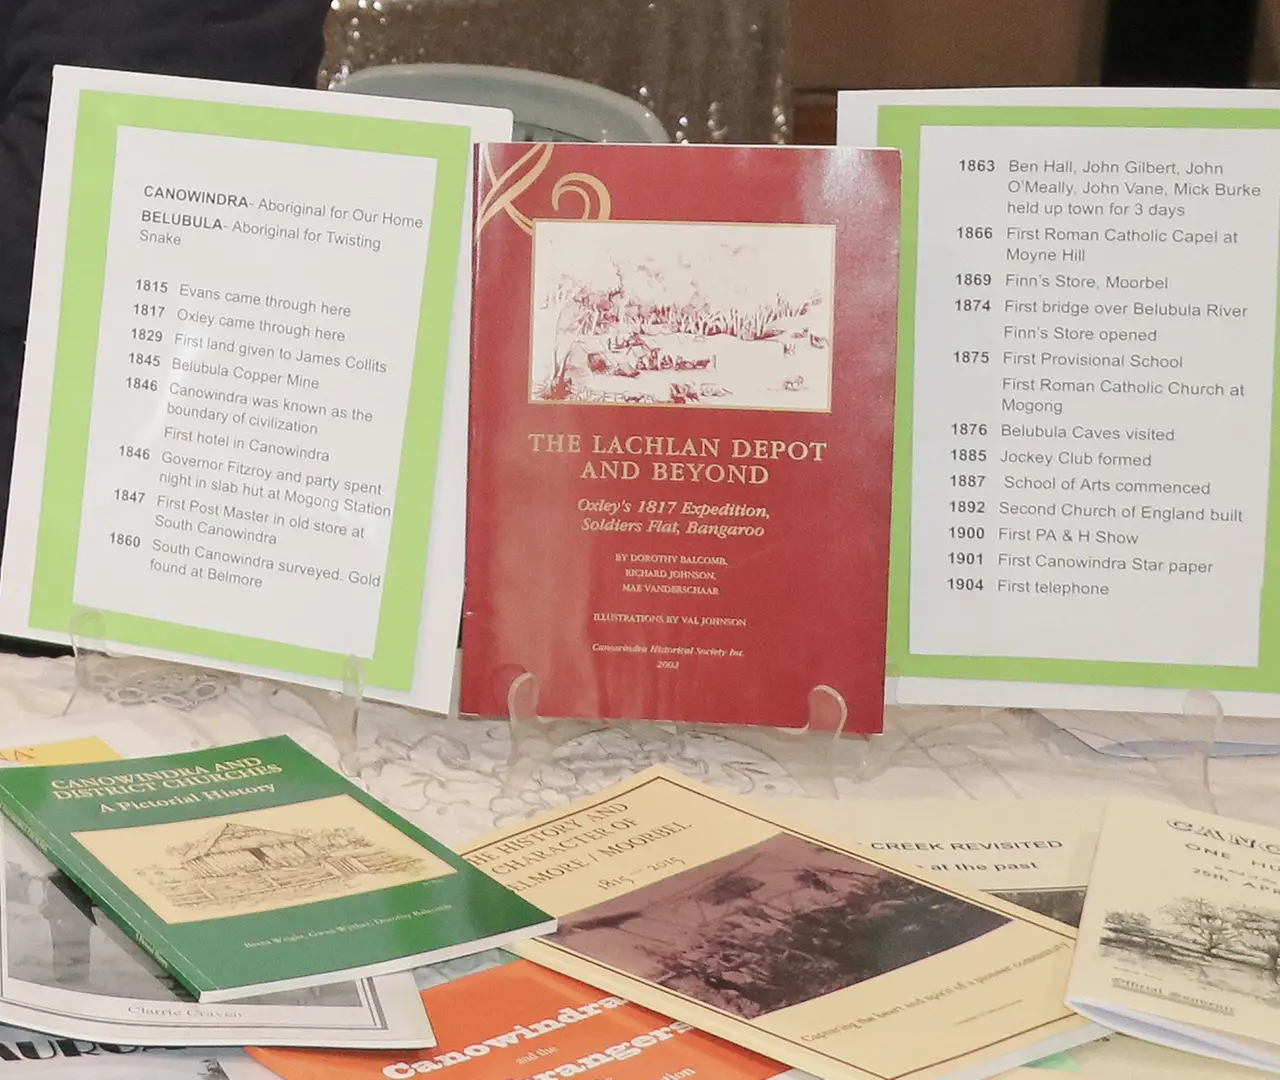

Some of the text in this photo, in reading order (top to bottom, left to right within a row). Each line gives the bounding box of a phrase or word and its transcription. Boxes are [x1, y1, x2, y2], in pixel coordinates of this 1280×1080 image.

[959, 159, 1223, 175] 1863 Ben Hall, John Gilbert, John
[258, 198, 325, 217] Aboriginal
[330, 206, 348, 219] for
[352, 209, 378, 223] Our
[382, 212, 423, 228] Home
[140, 229, 181, 245] Snake
[232, 220, 299, 239] Aboriginal
[304, 228, 322, 242] for
[327, 231, 381, 252] Twisting
[955, 273, 1168, 290] 1869 Finn's Store, Moorbel
[136, 279, 351, 317] 1815 Evans came through here
[131, 328, 386, 370] 1829 First land given to James Collits
[529, 434, 828, 462] THE LACHLAN DEPOT
[580, 461, 769, 484] AND BEYOND
[950, 475, 1210, 495] 1887 School of Arts commenced
[578, 498, 770, 519] Oxley's 1817 Expedition,
[581, 518, 765, 539] Soldiers Flat, Bangaroo
[615, 553, 629, 562] BY
[630, 554, 678, 563] DOROTHY
[625, 569, 667, 578] RICHARD
[947, 578, 1109, 596] 1904 First telephone
[51, 757, 262, 790] CANOWINDRA AND
[52, 764, 283, 801] DISTRICT CHURCHES
[99, 782, 276, 814] A Pictorial History
[467, 801, 629, 865] HE HISTORY AND
[491, 816, 639, 876] CHARACTER OF
[507, 821, 693, 891] ELMORE MOORBEL
[871, 840, 1063, 851] CREEK REVISITED
[1185, 843, 1231, 860] ONE
[597, 855, 686, 891] 1815 2015
[930, 861, 1040, 873] at the past
[381, 994, 629, 1079] Canowindra
[515, 1044, 559, 1065] and the
